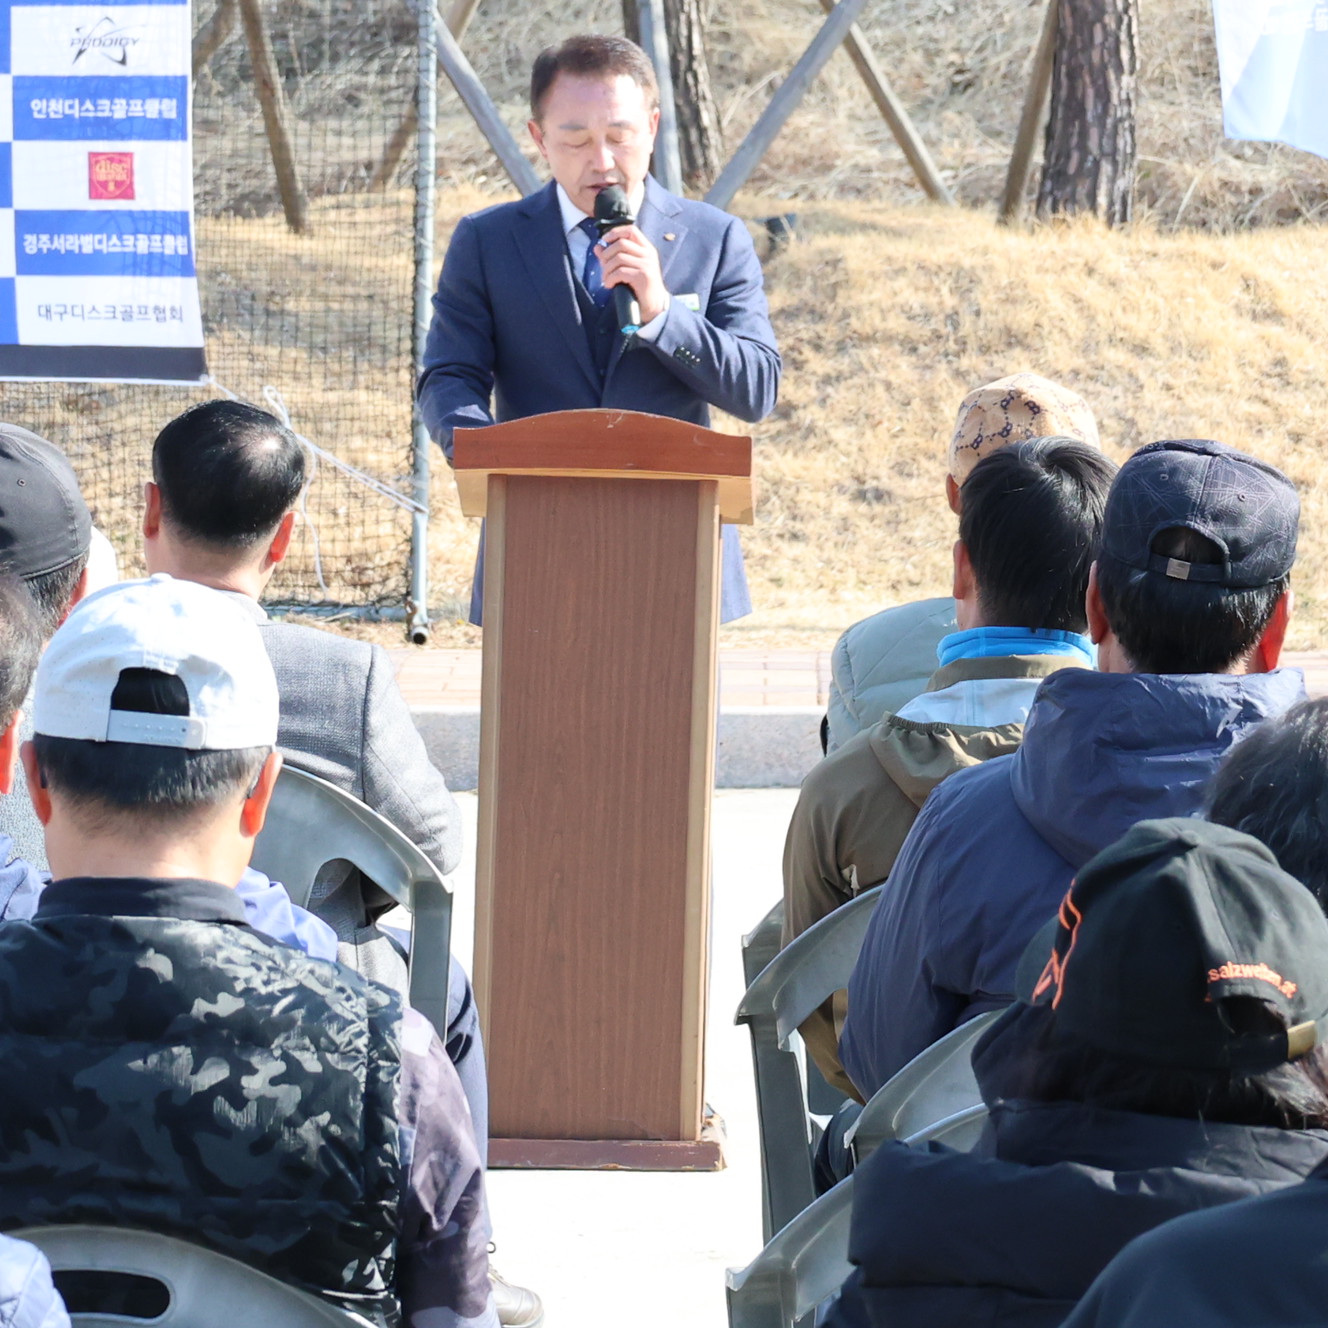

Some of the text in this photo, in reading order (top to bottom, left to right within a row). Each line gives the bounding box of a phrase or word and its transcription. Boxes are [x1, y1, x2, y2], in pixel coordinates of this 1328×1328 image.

[69, 34, 141, 50] PRODIGY
[30, 97, 178, 121] 인천디스크골프클럽
[22, 232, 189, 258] 경주서라벌디스크골프클럽
[37, 302, 183, 325] 대구디스크골프협회
